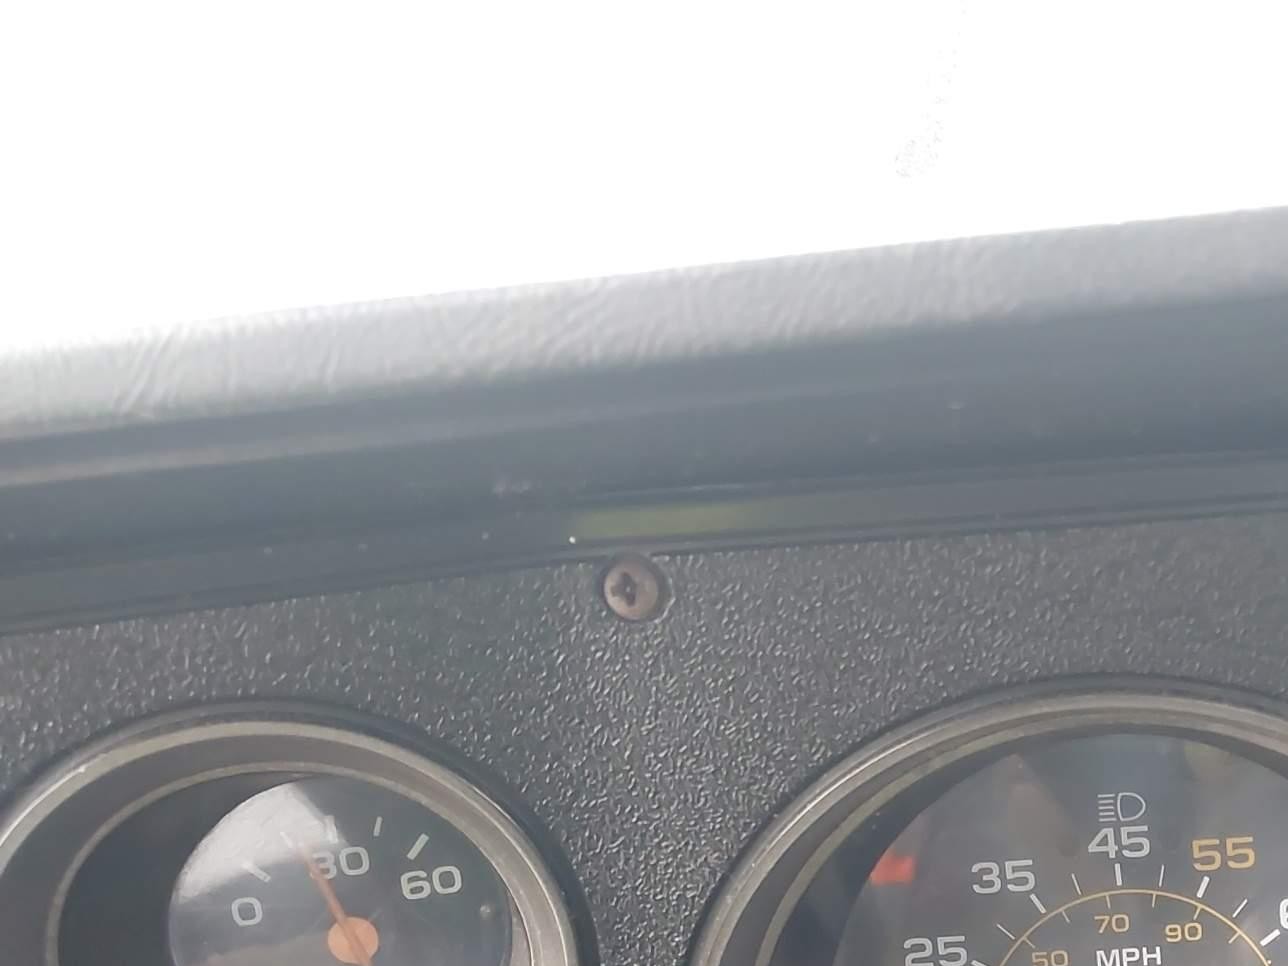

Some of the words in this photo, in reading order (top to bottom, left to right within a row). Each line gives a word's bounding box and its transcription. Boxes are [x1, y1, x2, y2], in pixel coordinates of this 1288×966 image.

[1087, 826, 1151, 859] 45
[1192, 836, 1256, 871] 55
[311, 846, 370, 880] 30
[971, 860, 1036, 894] 35
[401, 865, 463, 900] 60
[231, 897, 263, 926] 0
[1094, 914, 1130, 934] 70
[1165, 922, 1203, 943] 90
